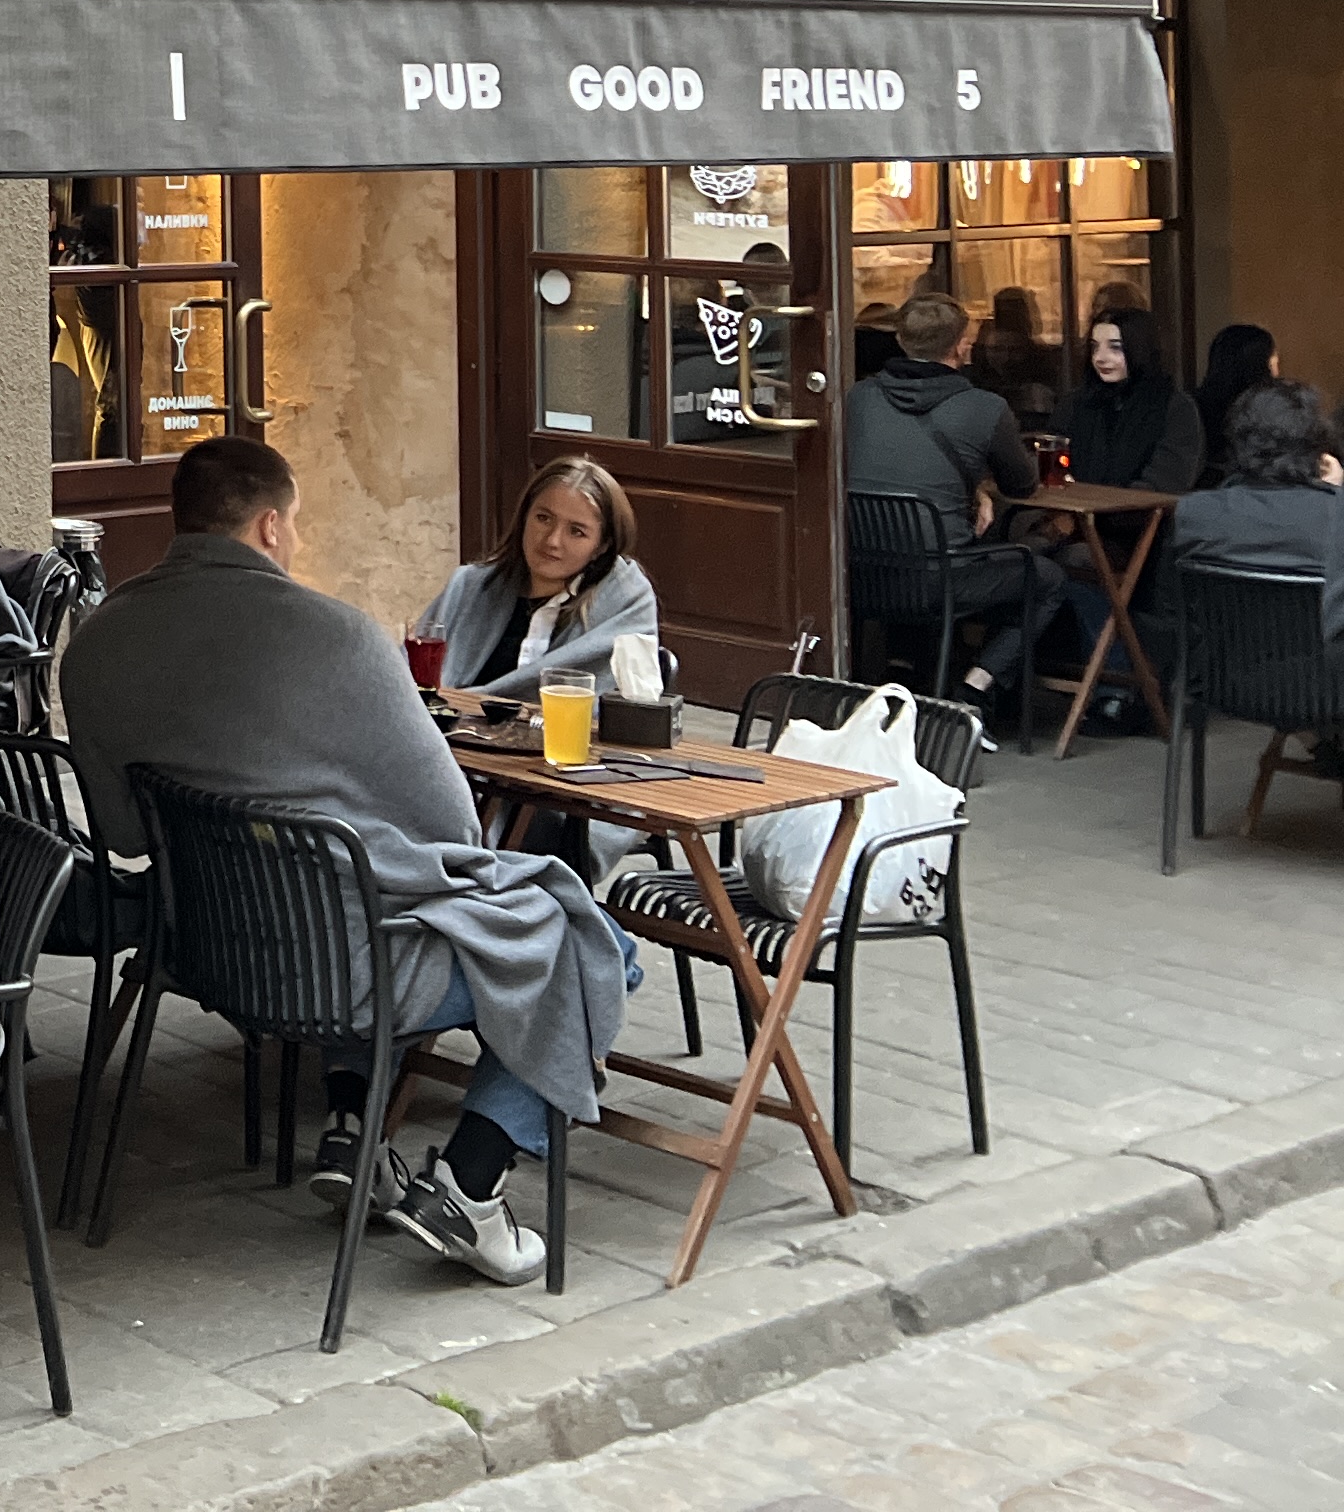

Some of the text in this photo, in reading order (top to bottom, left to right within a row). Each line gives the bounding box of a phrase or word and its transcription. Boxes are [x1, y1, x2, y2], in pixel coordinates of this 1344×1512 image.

[402, 62, 981, 112] PUB GOOD FRIEND 5
[144, 214, 209, 229] НАЛИВКИ
[163, 416, 199, 431] ВИНО
